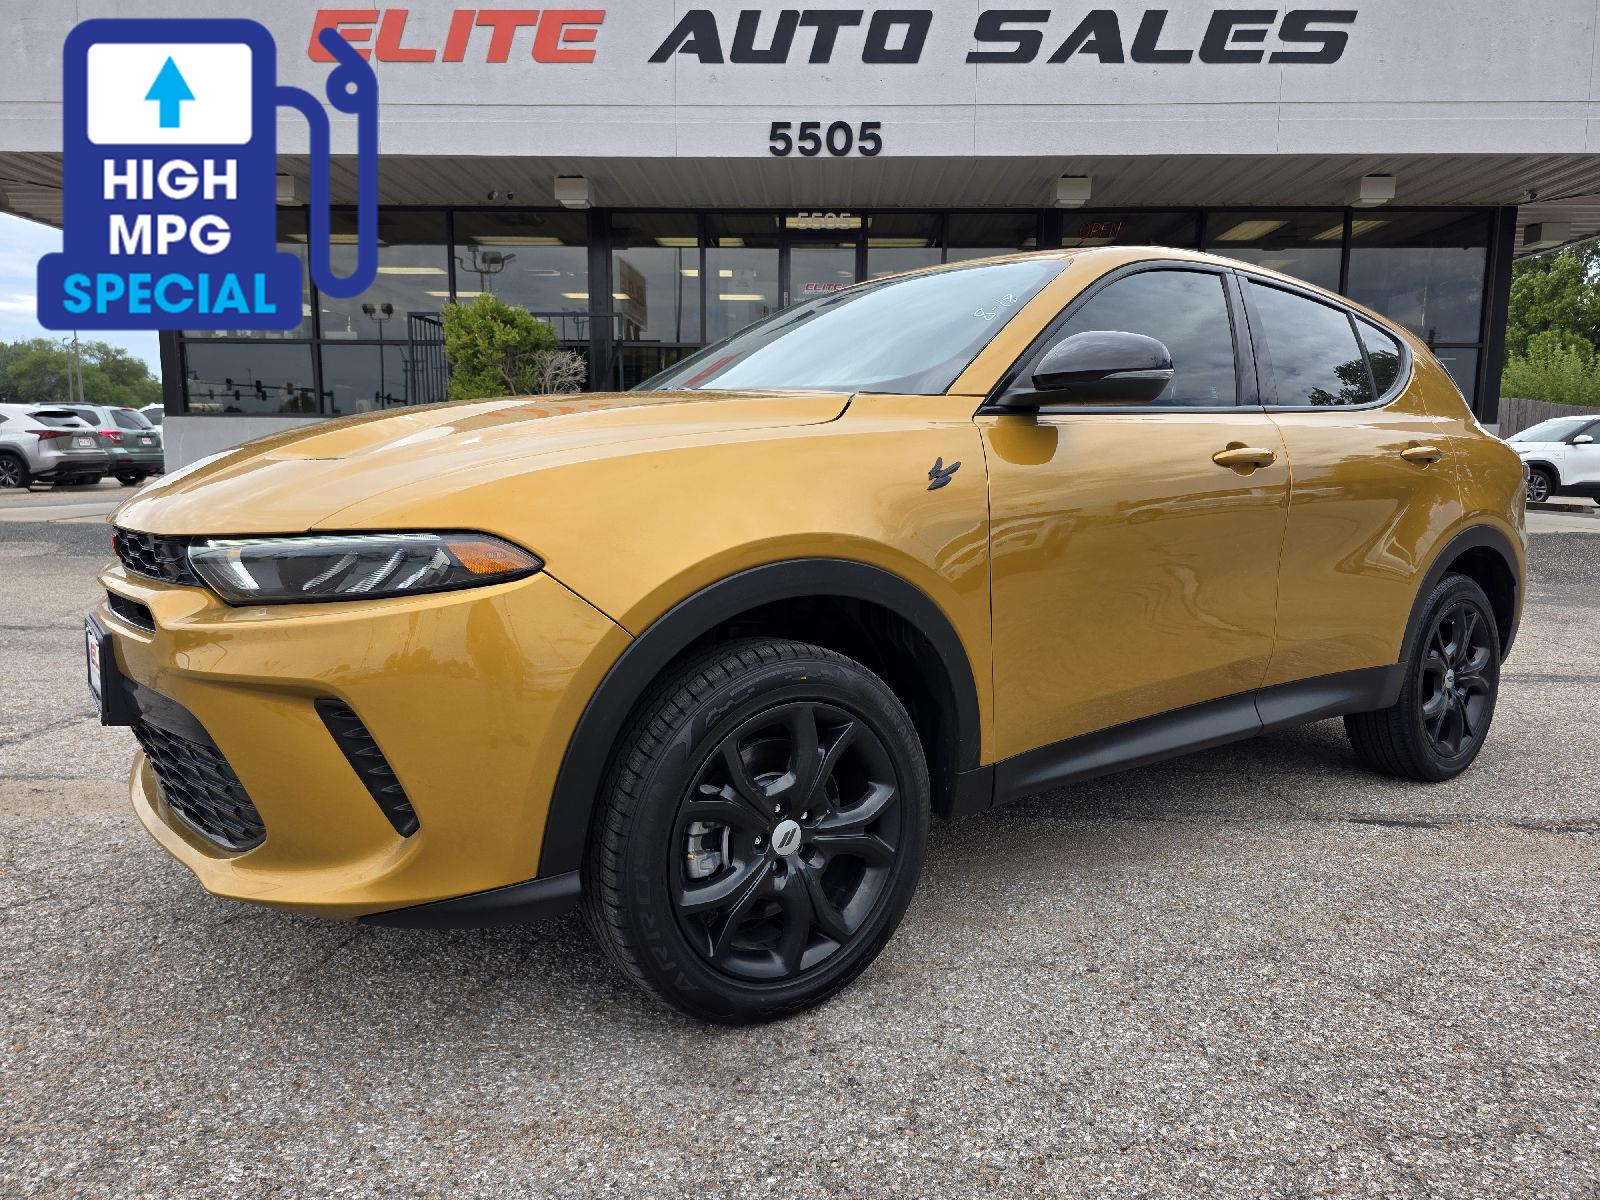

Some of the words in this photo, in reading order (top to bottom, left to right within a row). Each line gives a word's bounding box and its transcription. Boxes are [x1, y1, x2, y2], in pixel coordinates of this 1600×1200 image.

[307, 9, 606, 63] ELITE
[647, 9, 933, 64] AUTO
[965, 9, 1359, 65] SALES
[769, 120, 883, 157] 5505
[797, 212, 851, 230] 5505
[804, 282, 844, 292] ELITE
